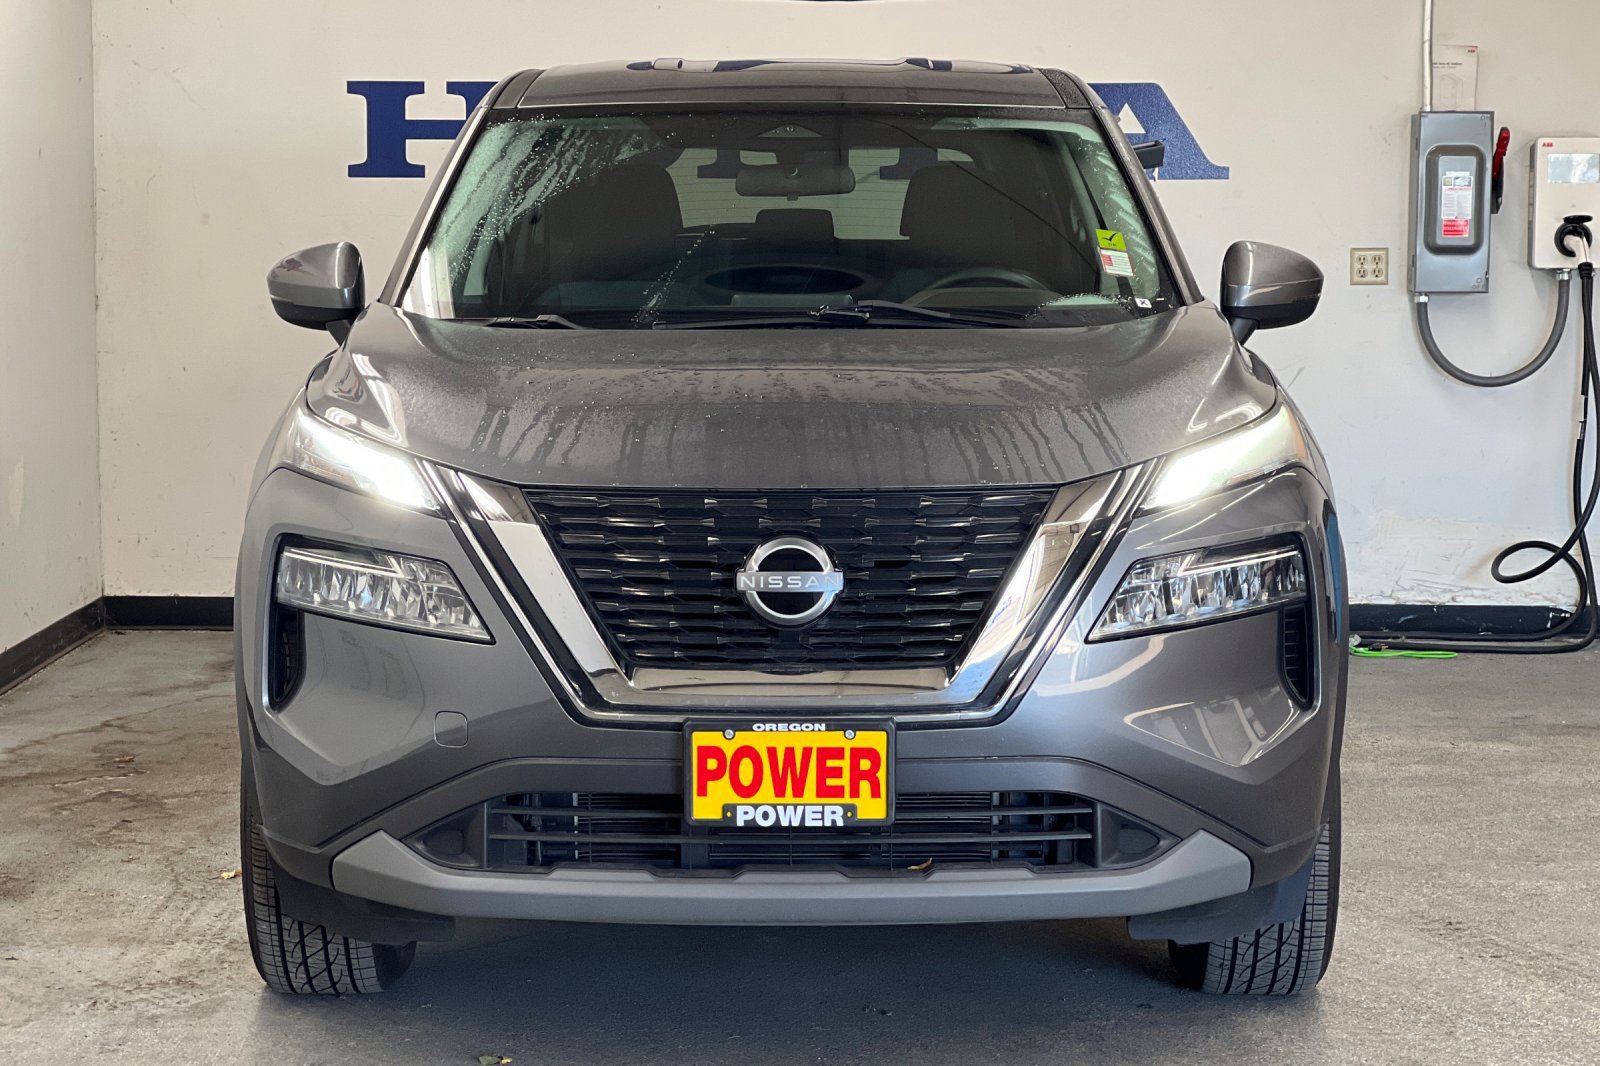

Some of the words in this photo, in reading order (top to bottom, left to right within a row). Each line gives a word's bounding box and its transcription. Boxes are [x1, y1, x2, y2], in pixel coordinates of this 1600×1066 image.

[740, 575, 840, 588] NISSAN
[752, 723, 827, 732] OREGON
[696, 745, 881, 799] POWER
[736, 805, 844, 827] POWER
